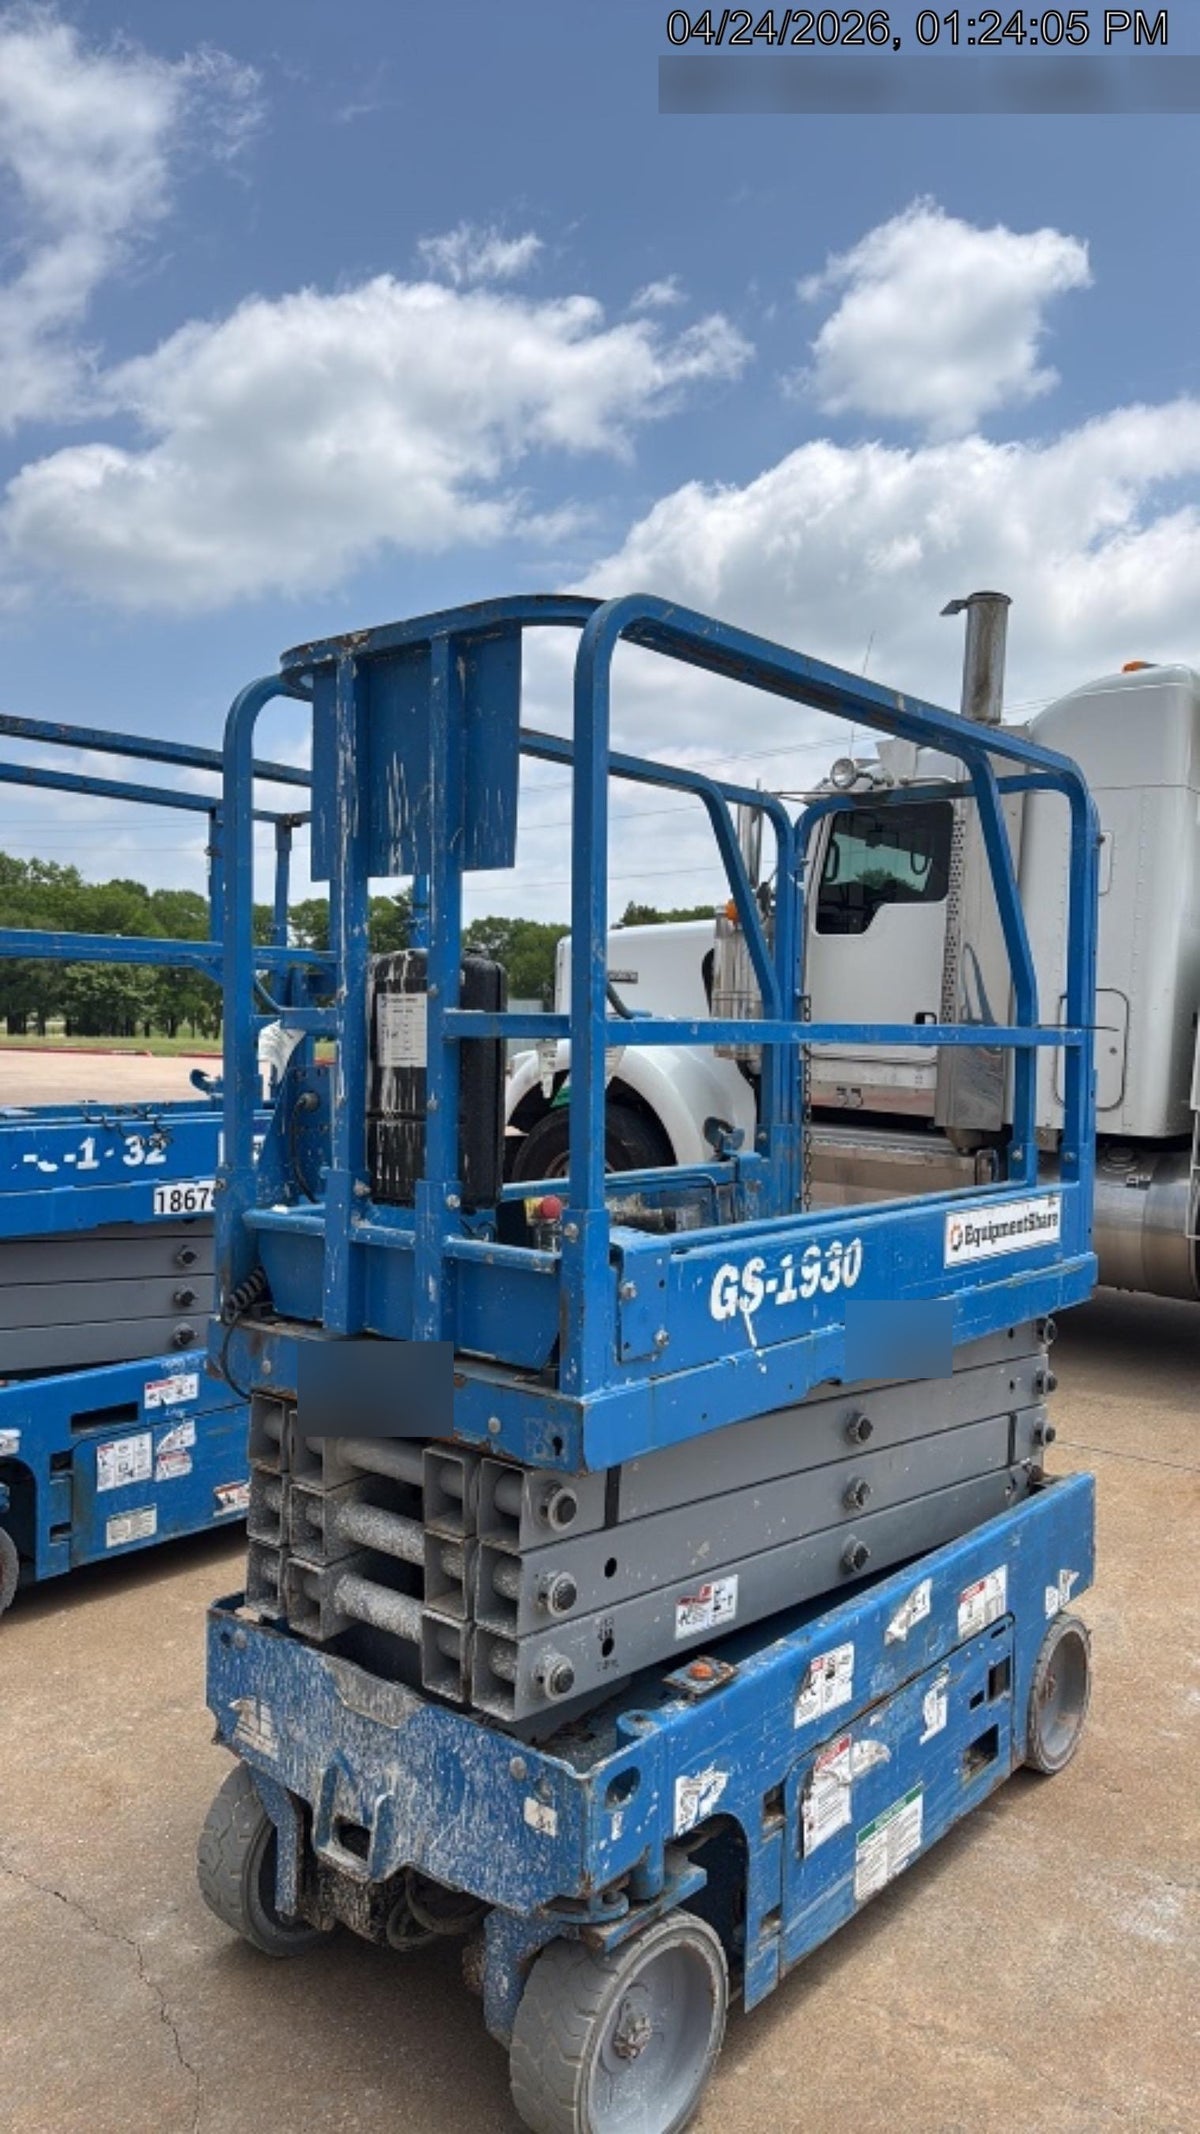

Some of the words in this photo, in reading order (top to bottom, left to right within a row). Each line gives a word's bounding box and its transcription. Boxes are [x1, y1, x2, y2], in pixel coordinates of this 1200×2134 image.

[156, 1187, 216, 1213] 1867
[964, 1212, 1059, 1248] EquipmentShare
[710, 1237, 863, 1321] GS-1930
